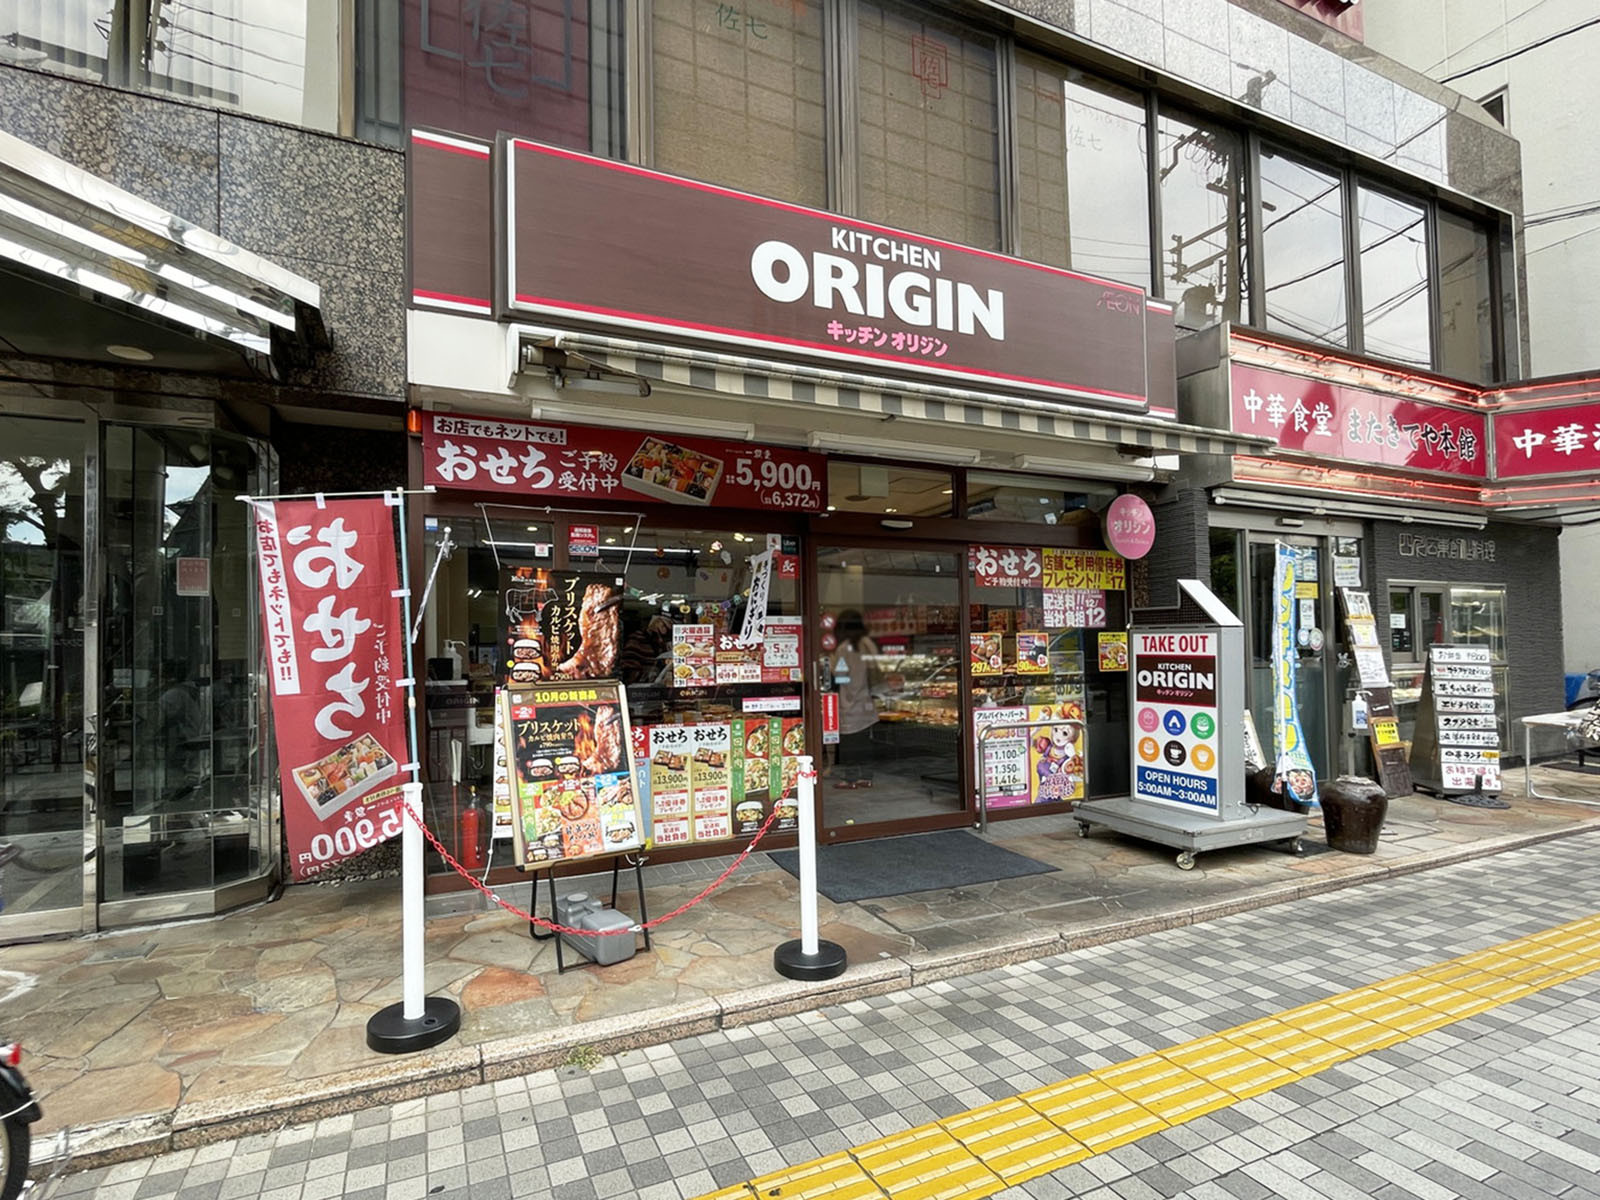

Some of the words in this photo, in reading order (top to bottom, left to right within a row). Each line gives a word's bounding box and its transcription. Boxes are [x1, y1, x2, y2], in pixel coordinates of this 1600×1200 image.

[831, 227, 941, 272] KITCHEN
[751, 240, 1006, 341] ORIGIN
[827, 320, 888, 348] キッチン
[891, 331, 949, 357] オリジン
[1243, 388, 1334, 437] 中華食堂
[1347, 408, 1477, 461] またきてや本館
[435, 439, 556, 490] おせち
[559, 449, 619, 473] ご予約
[558, 473, 620, 495] 受付中
[976, 546, 1041, 577] おせち
[1142, 636, 1175, 653] TAKE
[1179, 635, 1208, 653] OUT
[1157, 663, 1192, 671] KITCHEN
[1137, 670, 1215, 690] ORIGIN
[652, 729, 688, 744] おせち
[693, 727, 728, 742] おせち
[1144, 770, 1171, 784] OPEN
[1172, 773, 1207, 791] HOURS
